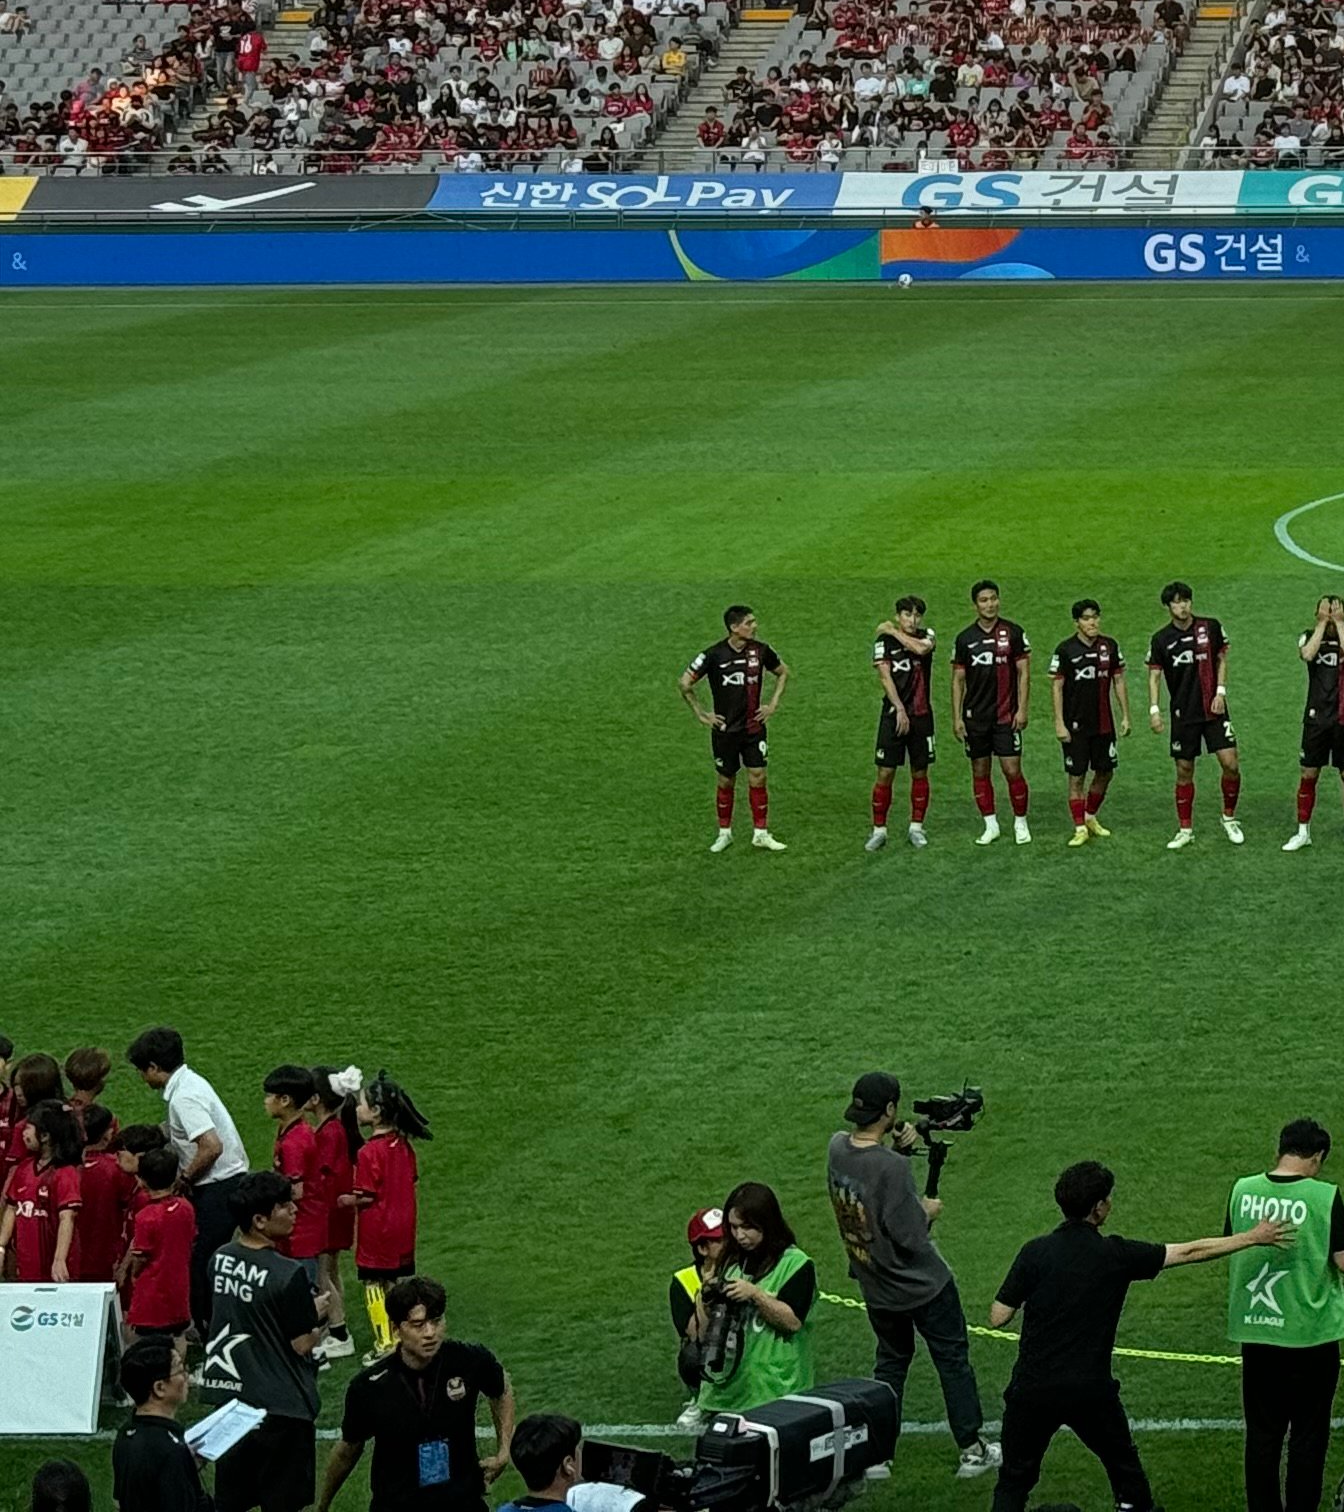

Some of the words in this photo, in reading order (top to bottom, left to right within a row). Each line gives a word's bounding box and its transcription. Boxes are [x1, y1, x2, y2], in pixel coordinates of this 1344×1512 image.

[479, 179, 577, 210] 신한
[686, 179, 796, 216] Pay
[902, 174, 1023, 212] GS
[1041, 174, 1179, 213] 건설
[1143, 232, 1206, 273] GS
[1214, 232, 1285, 273] 건설
[1240, 1194, 1307, 1226] PHOTO
[215, 1253, 269, 1288] TEAM
[214, 1275, 254, 1304] ENG
[37, 1312, 59, 1328] GS
[61, 1311, 85, 1329] 건설
[206, 1378, 243, 1393] LEAGUE
